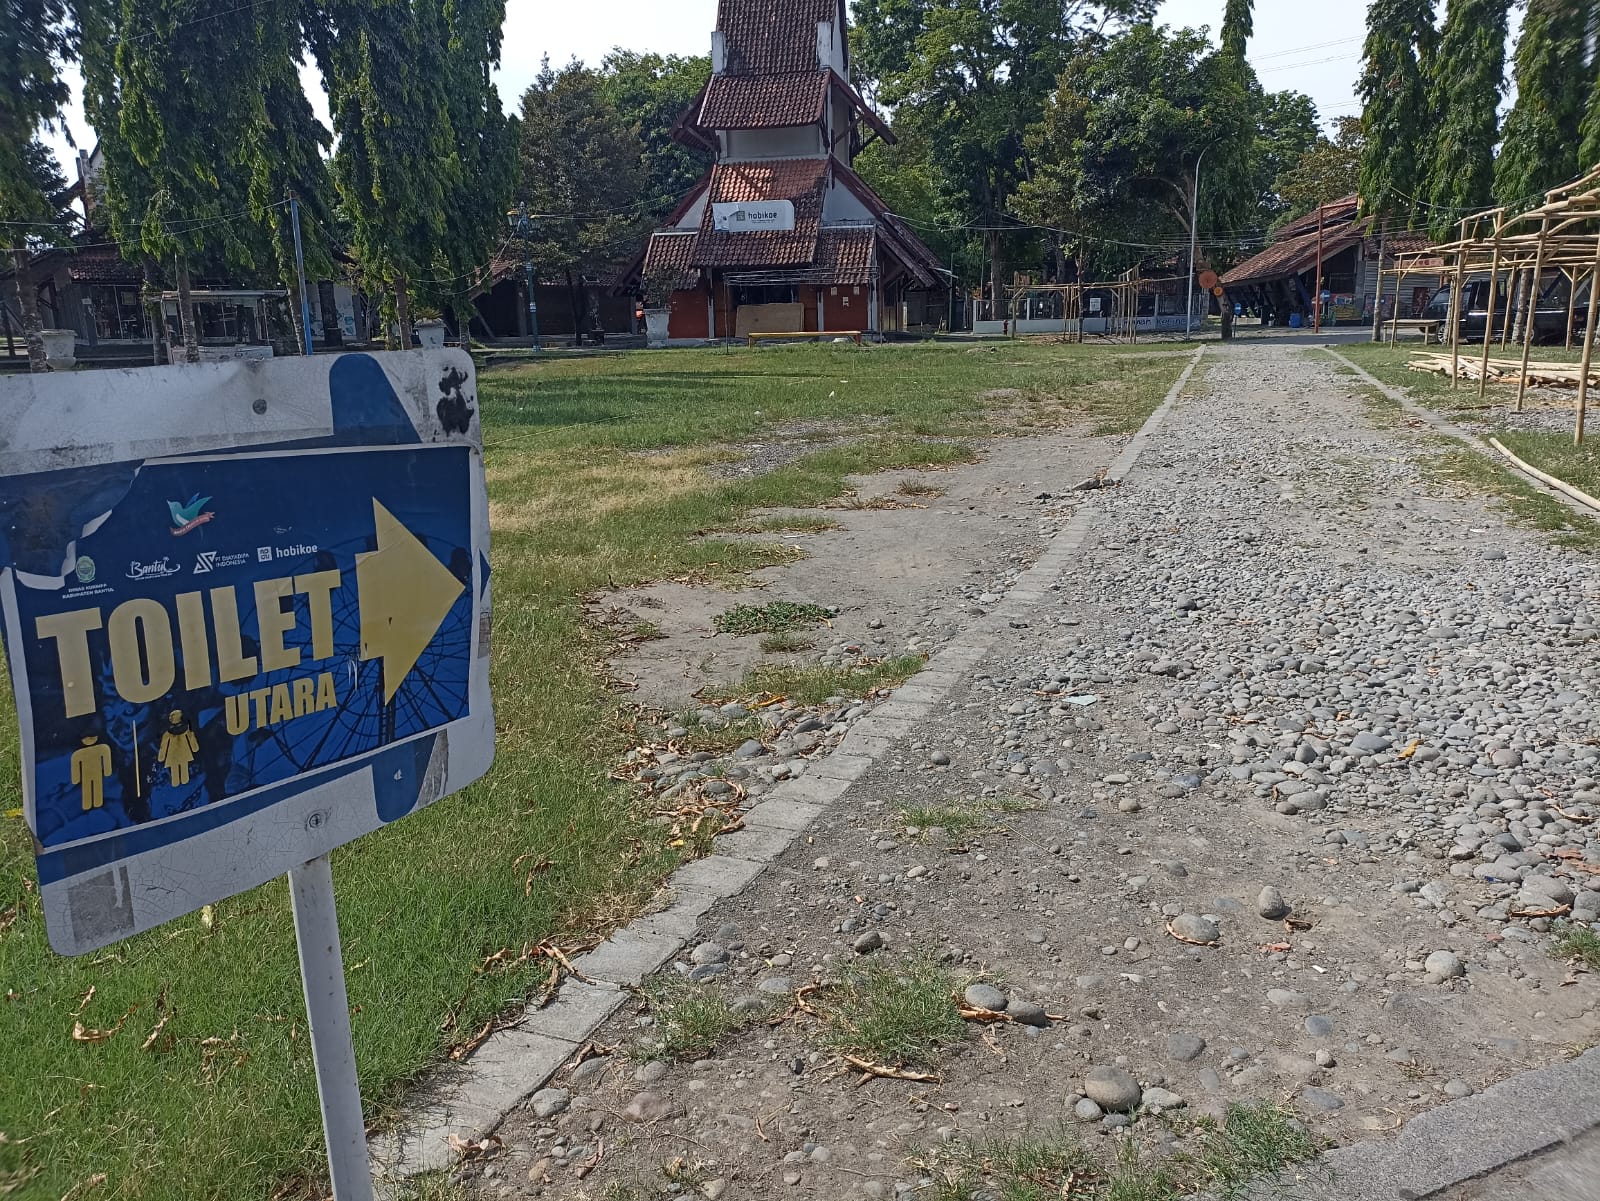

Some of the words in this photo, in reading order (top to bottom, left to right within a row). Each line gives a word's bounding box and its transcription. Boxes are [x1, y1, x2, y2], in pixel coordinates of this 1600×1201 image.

[748, 210, 778, 219] hobikoe
[275, 544, 319, 558] hobikoe
[125, 556, 181, 578] Bantul
[215, 558, 246, 567] INDONESIA
[35, 569, 342, 718] TOILET
[224, 671, 337, 736] UTARA
